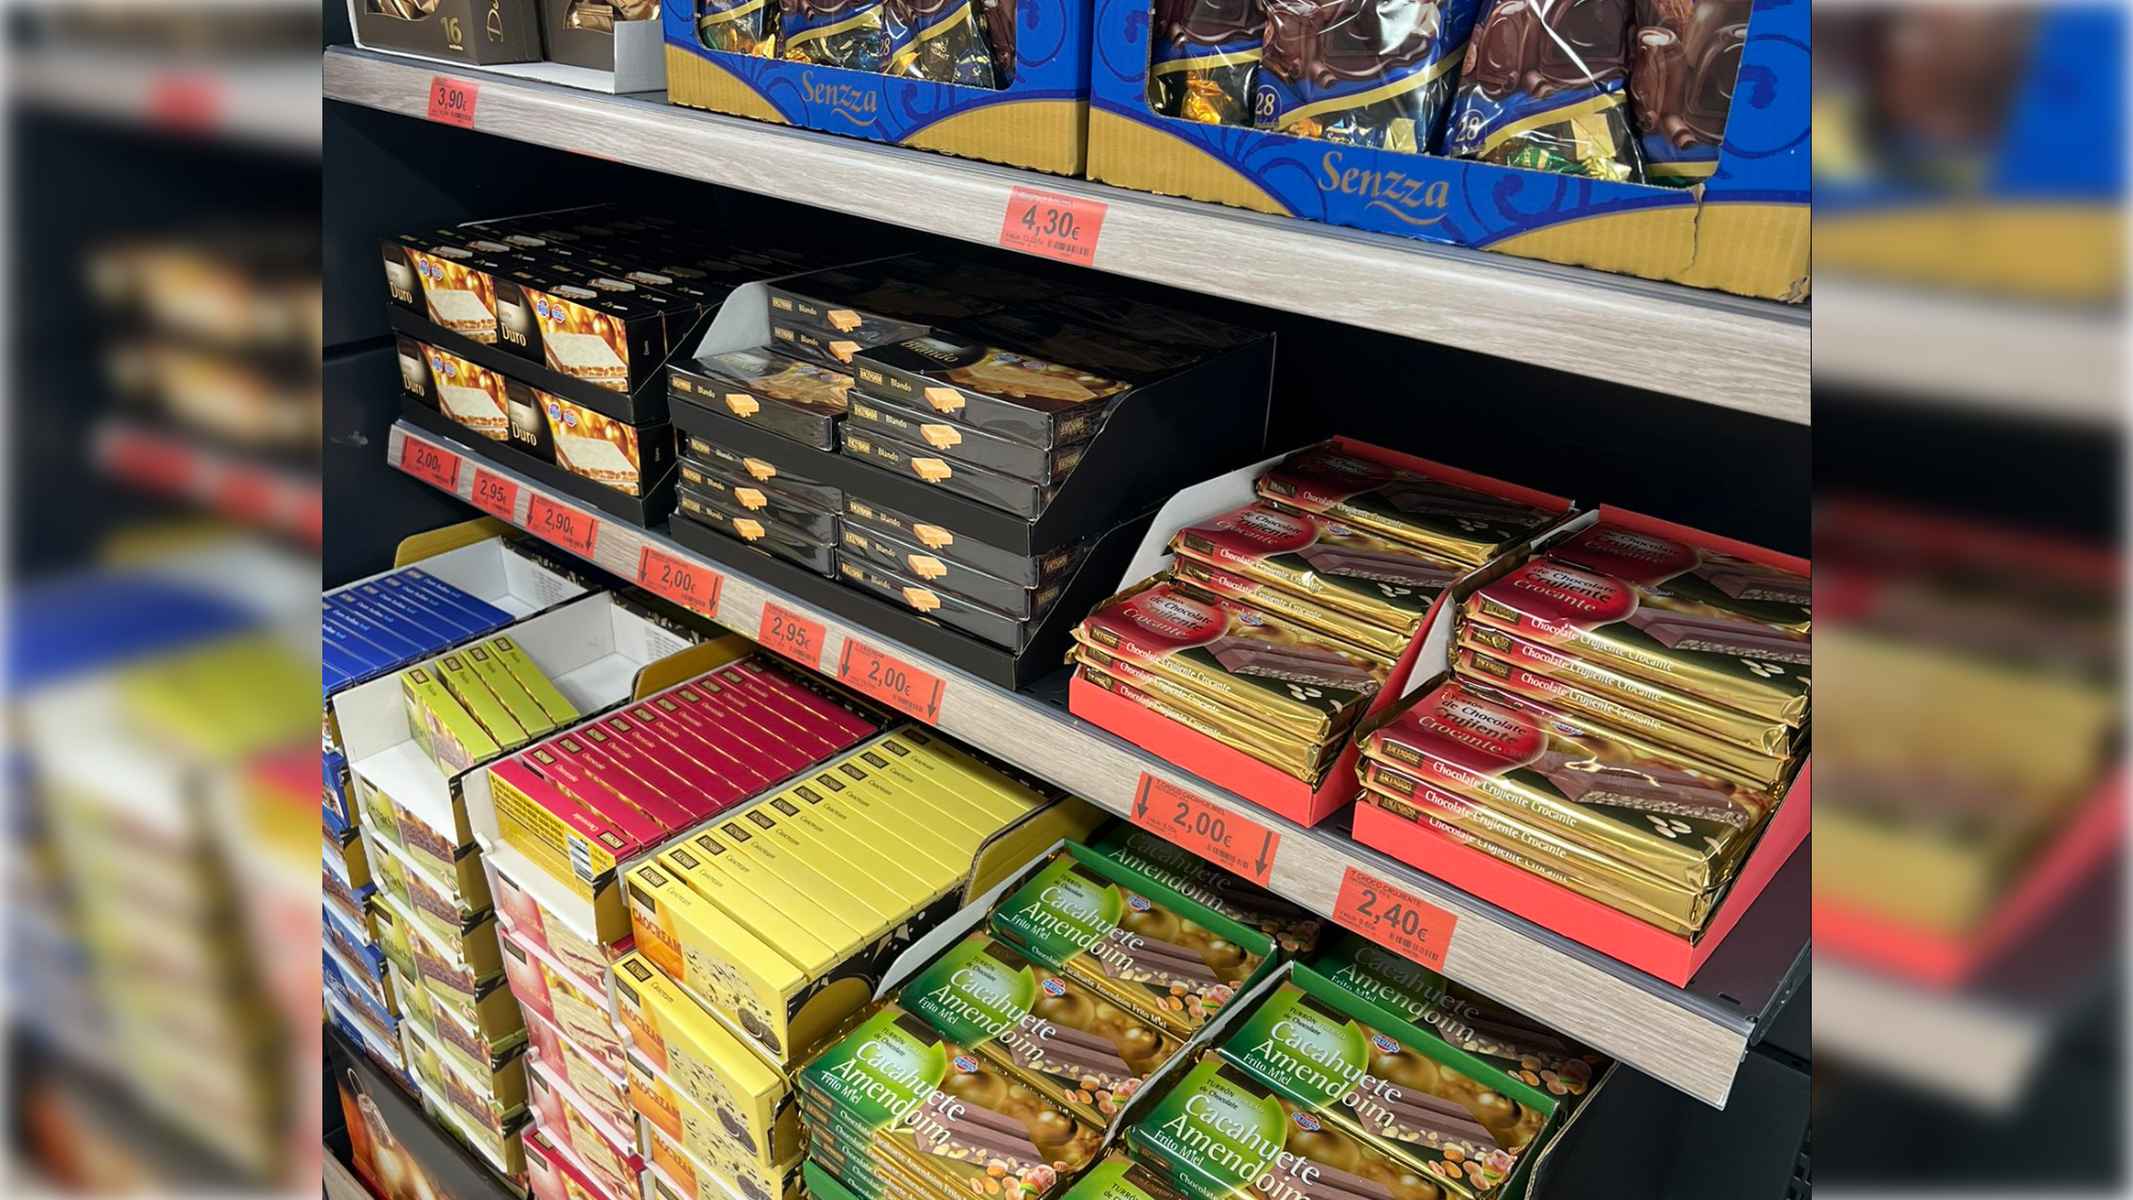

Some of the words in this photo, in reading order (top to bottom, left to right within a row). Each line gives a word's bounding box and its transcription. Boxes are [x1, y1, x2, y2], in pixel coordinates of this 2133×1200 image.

[441, 16, 463, 44] 16
[802, 70, 878, 118] Senzza
[1255, 92, 1275, 116] 28
[1456, 116, 1480, 142] 28
[1318, 151, 1449, 216] Senzza
[1022, 204, 1080, 240] 4,30€
[390, 282, 413, 304] Duro
[501, 325, 527, 347] Duro
[403, 374, 425, 397] Duro
[511, 422, 537, 447] Duro
[662, 566, 697, 593] 2,00€
[1513, 579, 1597, 612] Crocante
[1552, 571, 1617, 594] Chocolate
[1164, 602, 1214, 624] Chocolate
[1531, 616, 1580, 642] Chocolate
[772, 617, 810, 650] 2,95€
[1521, 645, 1573, 670] Chocolate
[868, 660, 912, 695] 2,00€
[1521, 673, 1569, 697] Chocolate
[1418, 715, 1503, 754] Crocante
[1441, 700, 1458, 711] de
[1462, 703, 1528, 736] Chocolate
[1432, 760, 1481, 788] Chocolate
[1482, 781, 1530, 809] Crujiente
[1530, 798, 1578, 828] Crocante
[1174, 801, 1232, 848] 2,00€
[1424, 789, 1474, 818] Chocolate
[1472, 810, 1520, 840] Crujiente
[1520, 830, 1568, 859] Crocante
[1110, 848, 1225, 913] Amendoim
[1040, 886, 1145, 951] Cacahuete
[1357, 889, 1428, 943] 2,40€
[1019, 900, 1135, 970] Amendoim
[950, 967, 1058, 1043] Cacahuete
[1336, 961, 1476, 1044] Amendoim
[927, 983, 1045, 1063] Amendoim
[1243, 1052, 1268, 1073] Frito
[1270, 1018, 1403, 1105] Cacahuete
[855, 1039, 967, 1122] Cacahuete
[1250, 1037, 1397, 1129] Amendoim
[830, 1058, 953, 1146] Amendoim
[1153, 1129, 1179, 1151] Frito
[1162, 1112, 1313, 1200] Amendoim
[1185, 1093, 1322, 1187] Cacahuete
